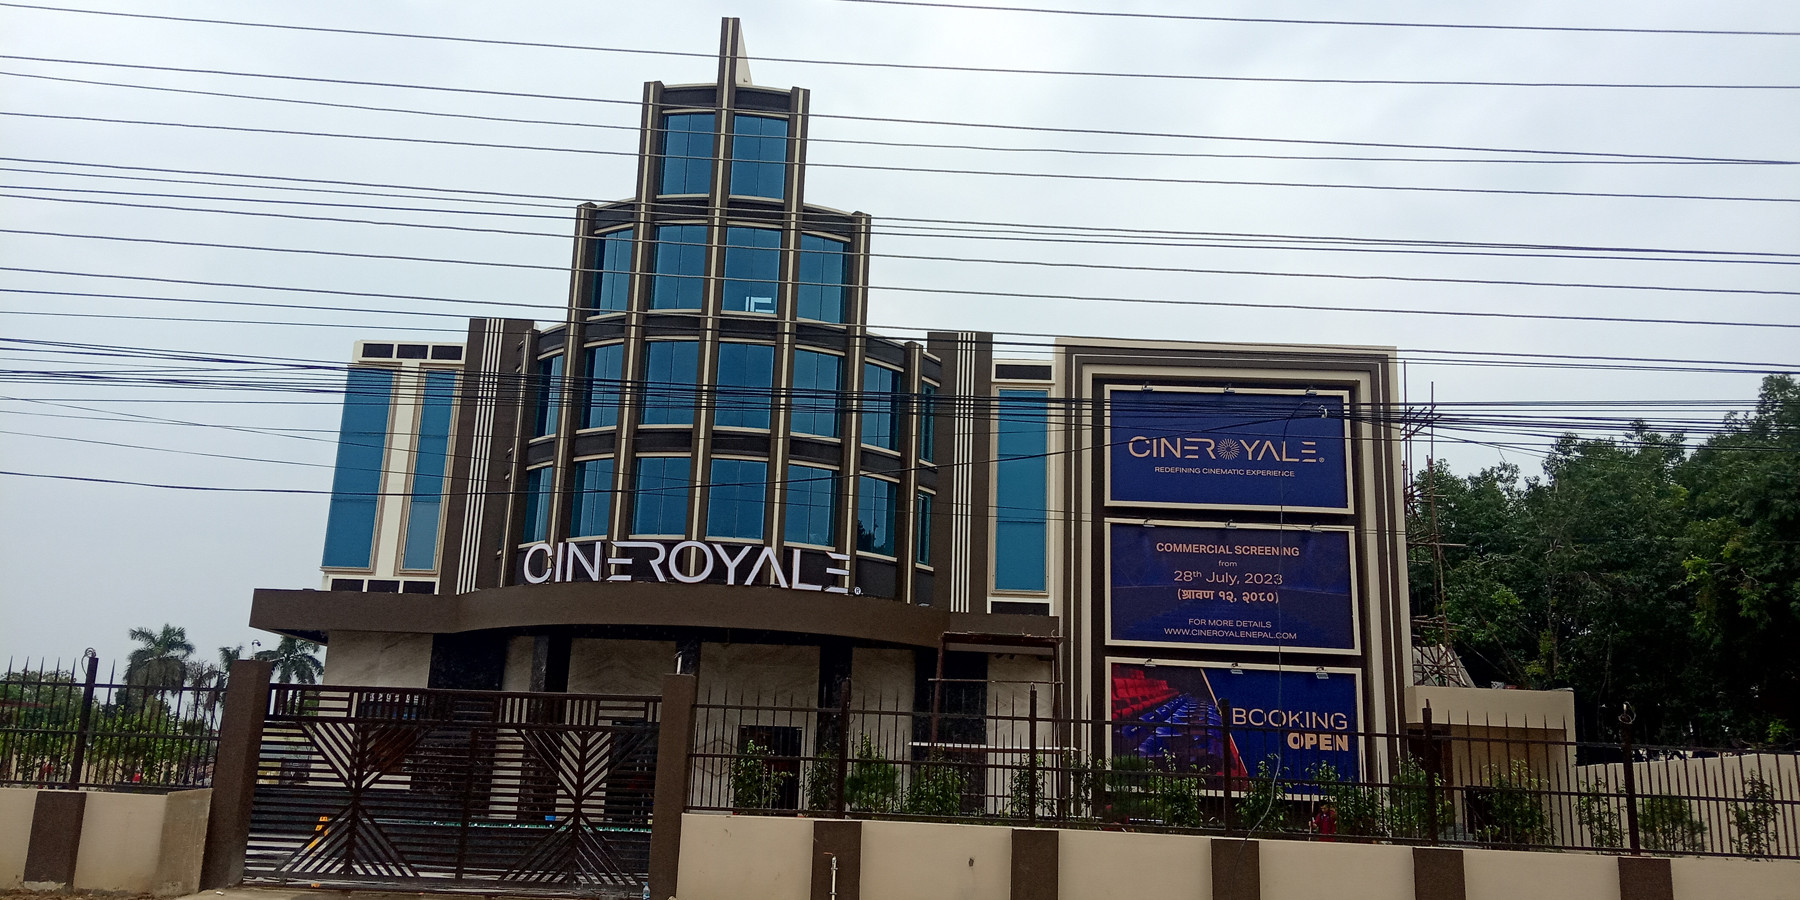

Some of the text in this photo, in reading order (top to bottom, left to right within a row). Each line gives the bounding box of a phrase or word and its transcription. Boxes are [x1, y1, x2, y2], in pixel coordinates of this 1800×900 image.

[1128, 436, 1317, 463] CINEROYALE
[1154, 466, 1296, 477] REDEFINING CINEMATIC EXPERIENCE
[1156, 542, 1233, 555] COMMERCIAL
[523, 540, 849, 594] CINEROYALE
[1173, 570, 1283, 586] 28th July, 2023
[1177, 588, 1215, 601] (श्रावण
[1188, 618, 1272, 629] FOR MORE DETAILS
[1164, 627, 1297, 640] WWW.CINEROYALENEPAL.COM
[1232, 707, 1348, 730] BOOKING
[1287, 732, 1349, 752] OPEN
